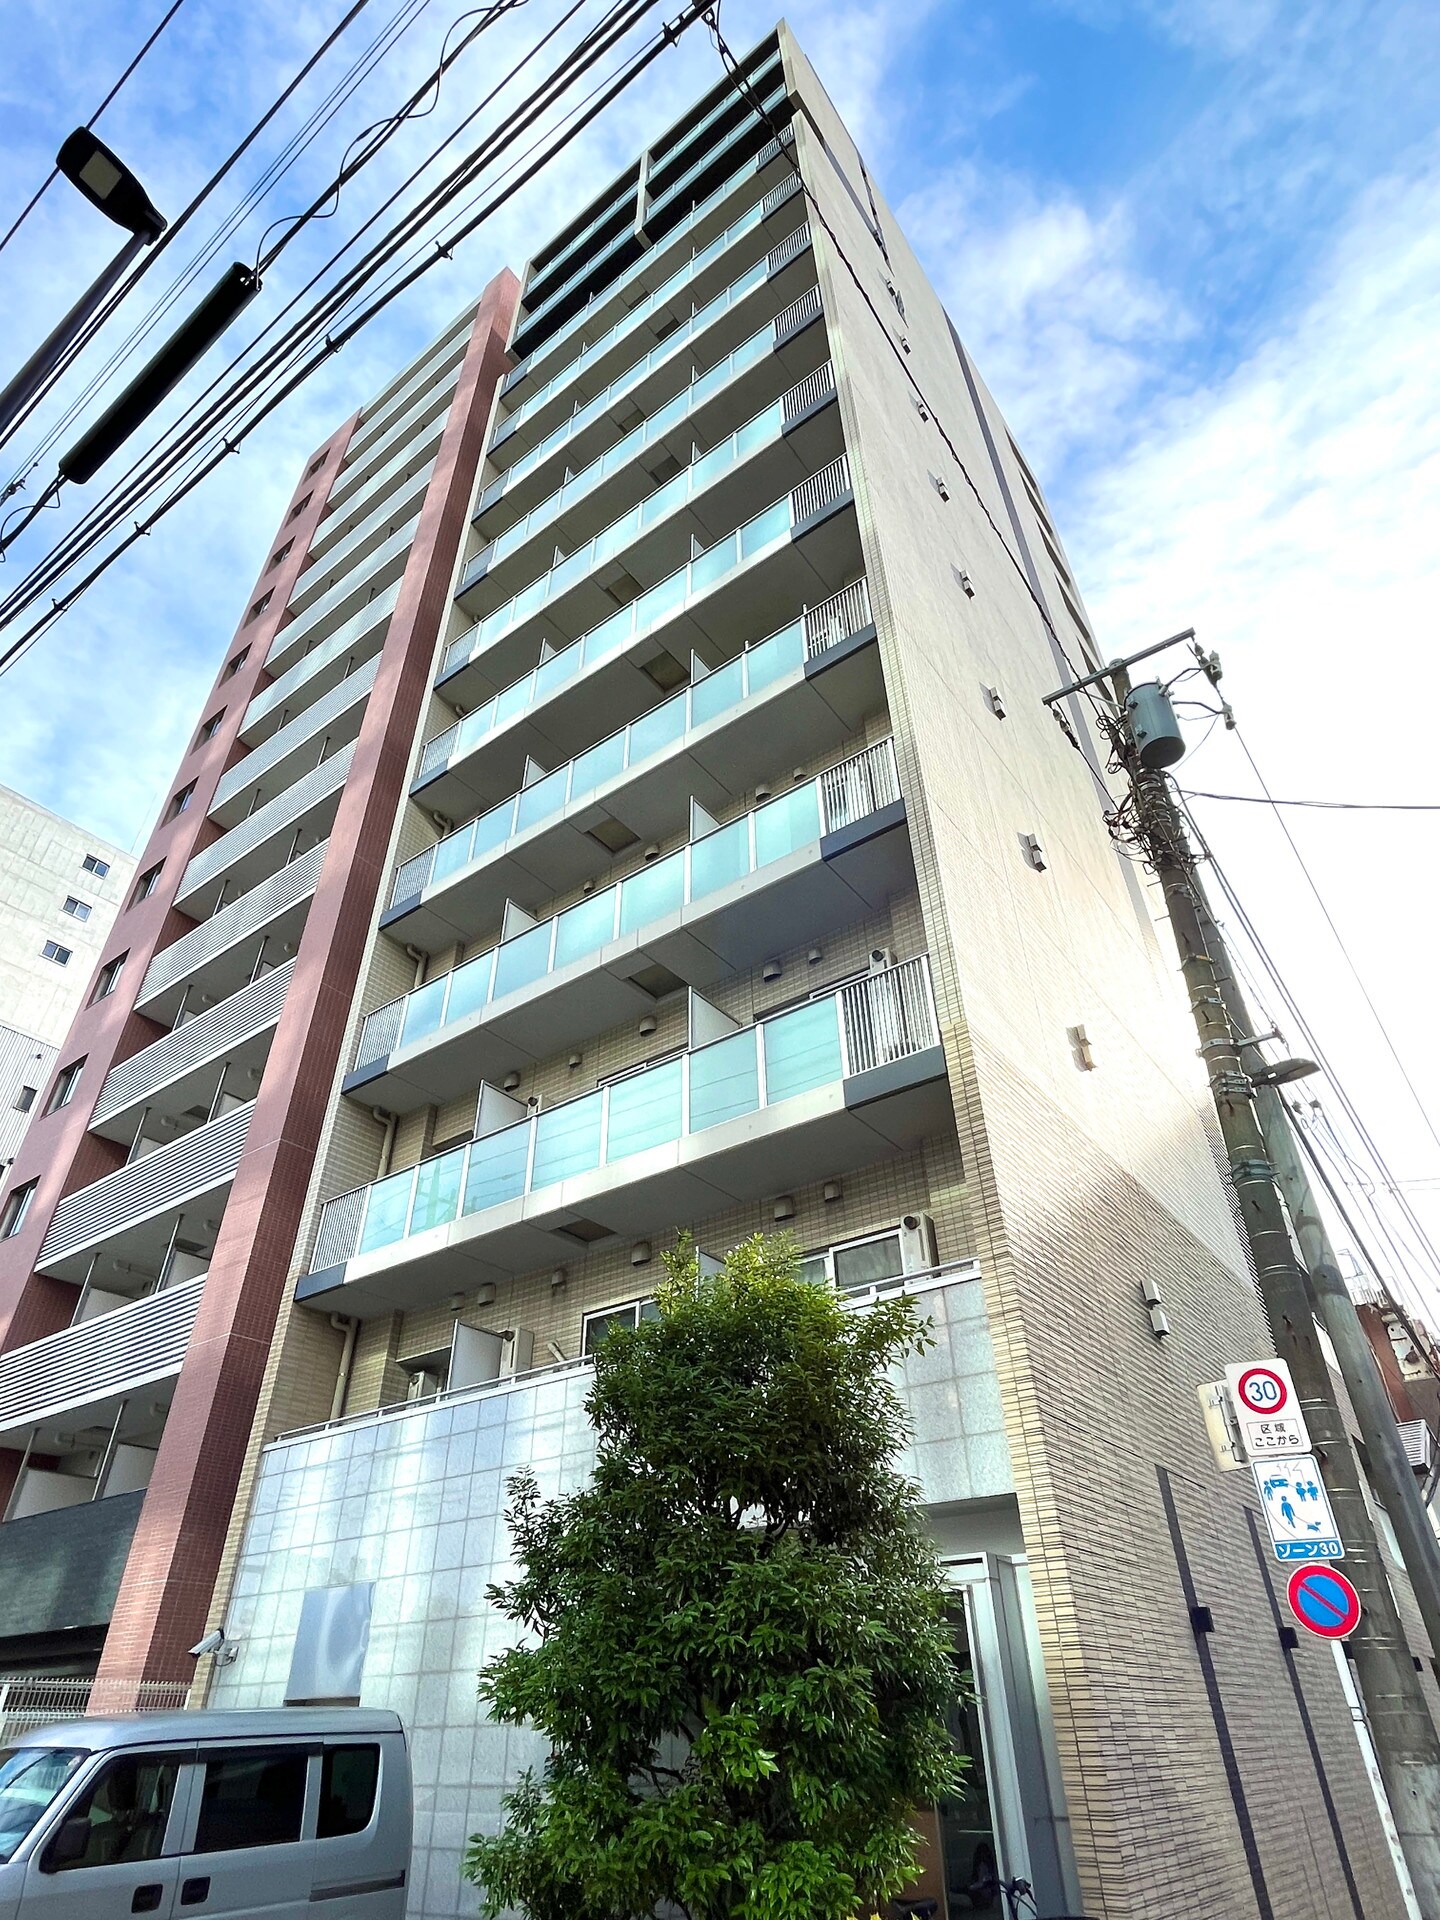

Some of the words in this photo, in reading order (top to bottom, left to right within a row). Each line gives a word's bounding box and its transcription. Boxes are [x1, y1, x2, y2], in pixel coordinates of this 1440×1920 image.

[1249, 1381, 1277, 1401] 30
[1260, 1423, 1286, 1434] 区域
[1255, 1435, 1299, 1447] ここから
